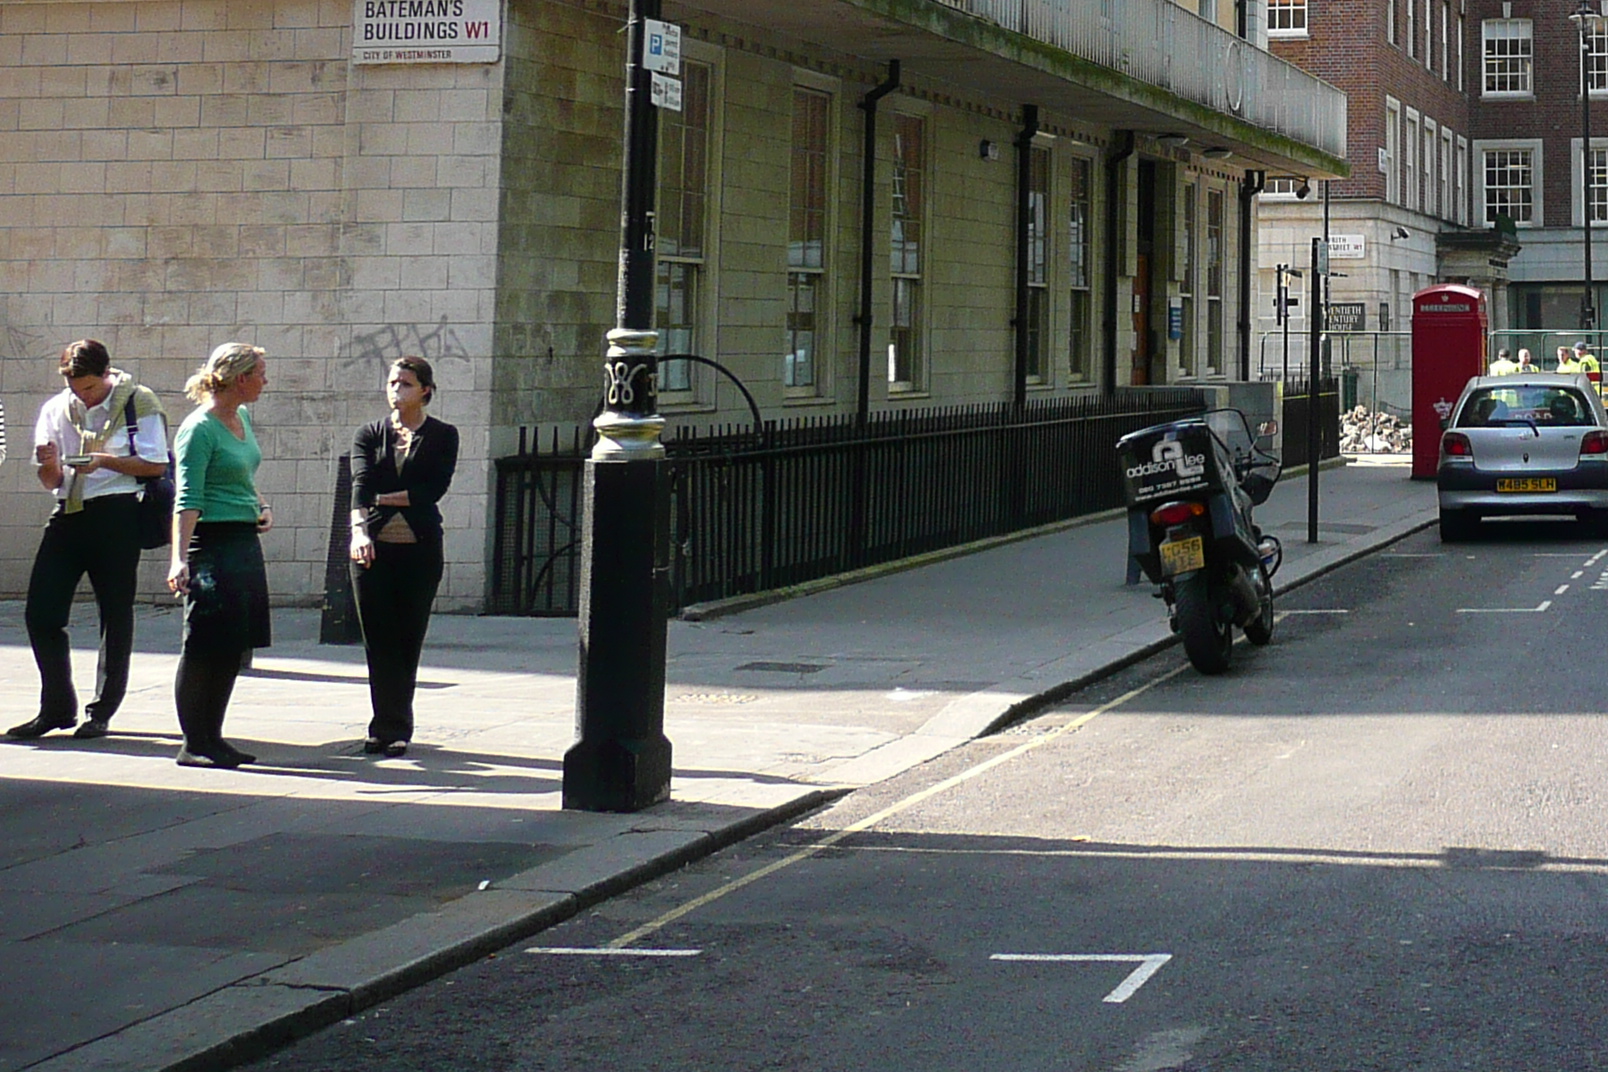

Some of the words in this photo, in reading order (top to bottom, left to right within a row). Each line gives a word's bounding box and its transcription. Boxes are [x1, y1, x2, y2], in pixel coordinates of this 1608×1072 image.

[364, 0, 464, 19] BATEMAN'S
[364, 21, 458, 40] BUILDINGS
[465, 21, 489, 39] W1
[363, 51, 380, 60] CITY
[383, 50, 393, 59] OF
[395, 49, 452, 60] WESTMINSTER
[1328, 314, 1358, 323] ENTURY
[1126, 460, 1175, 478] addison
[1184, 454, 1205, 466] lee
